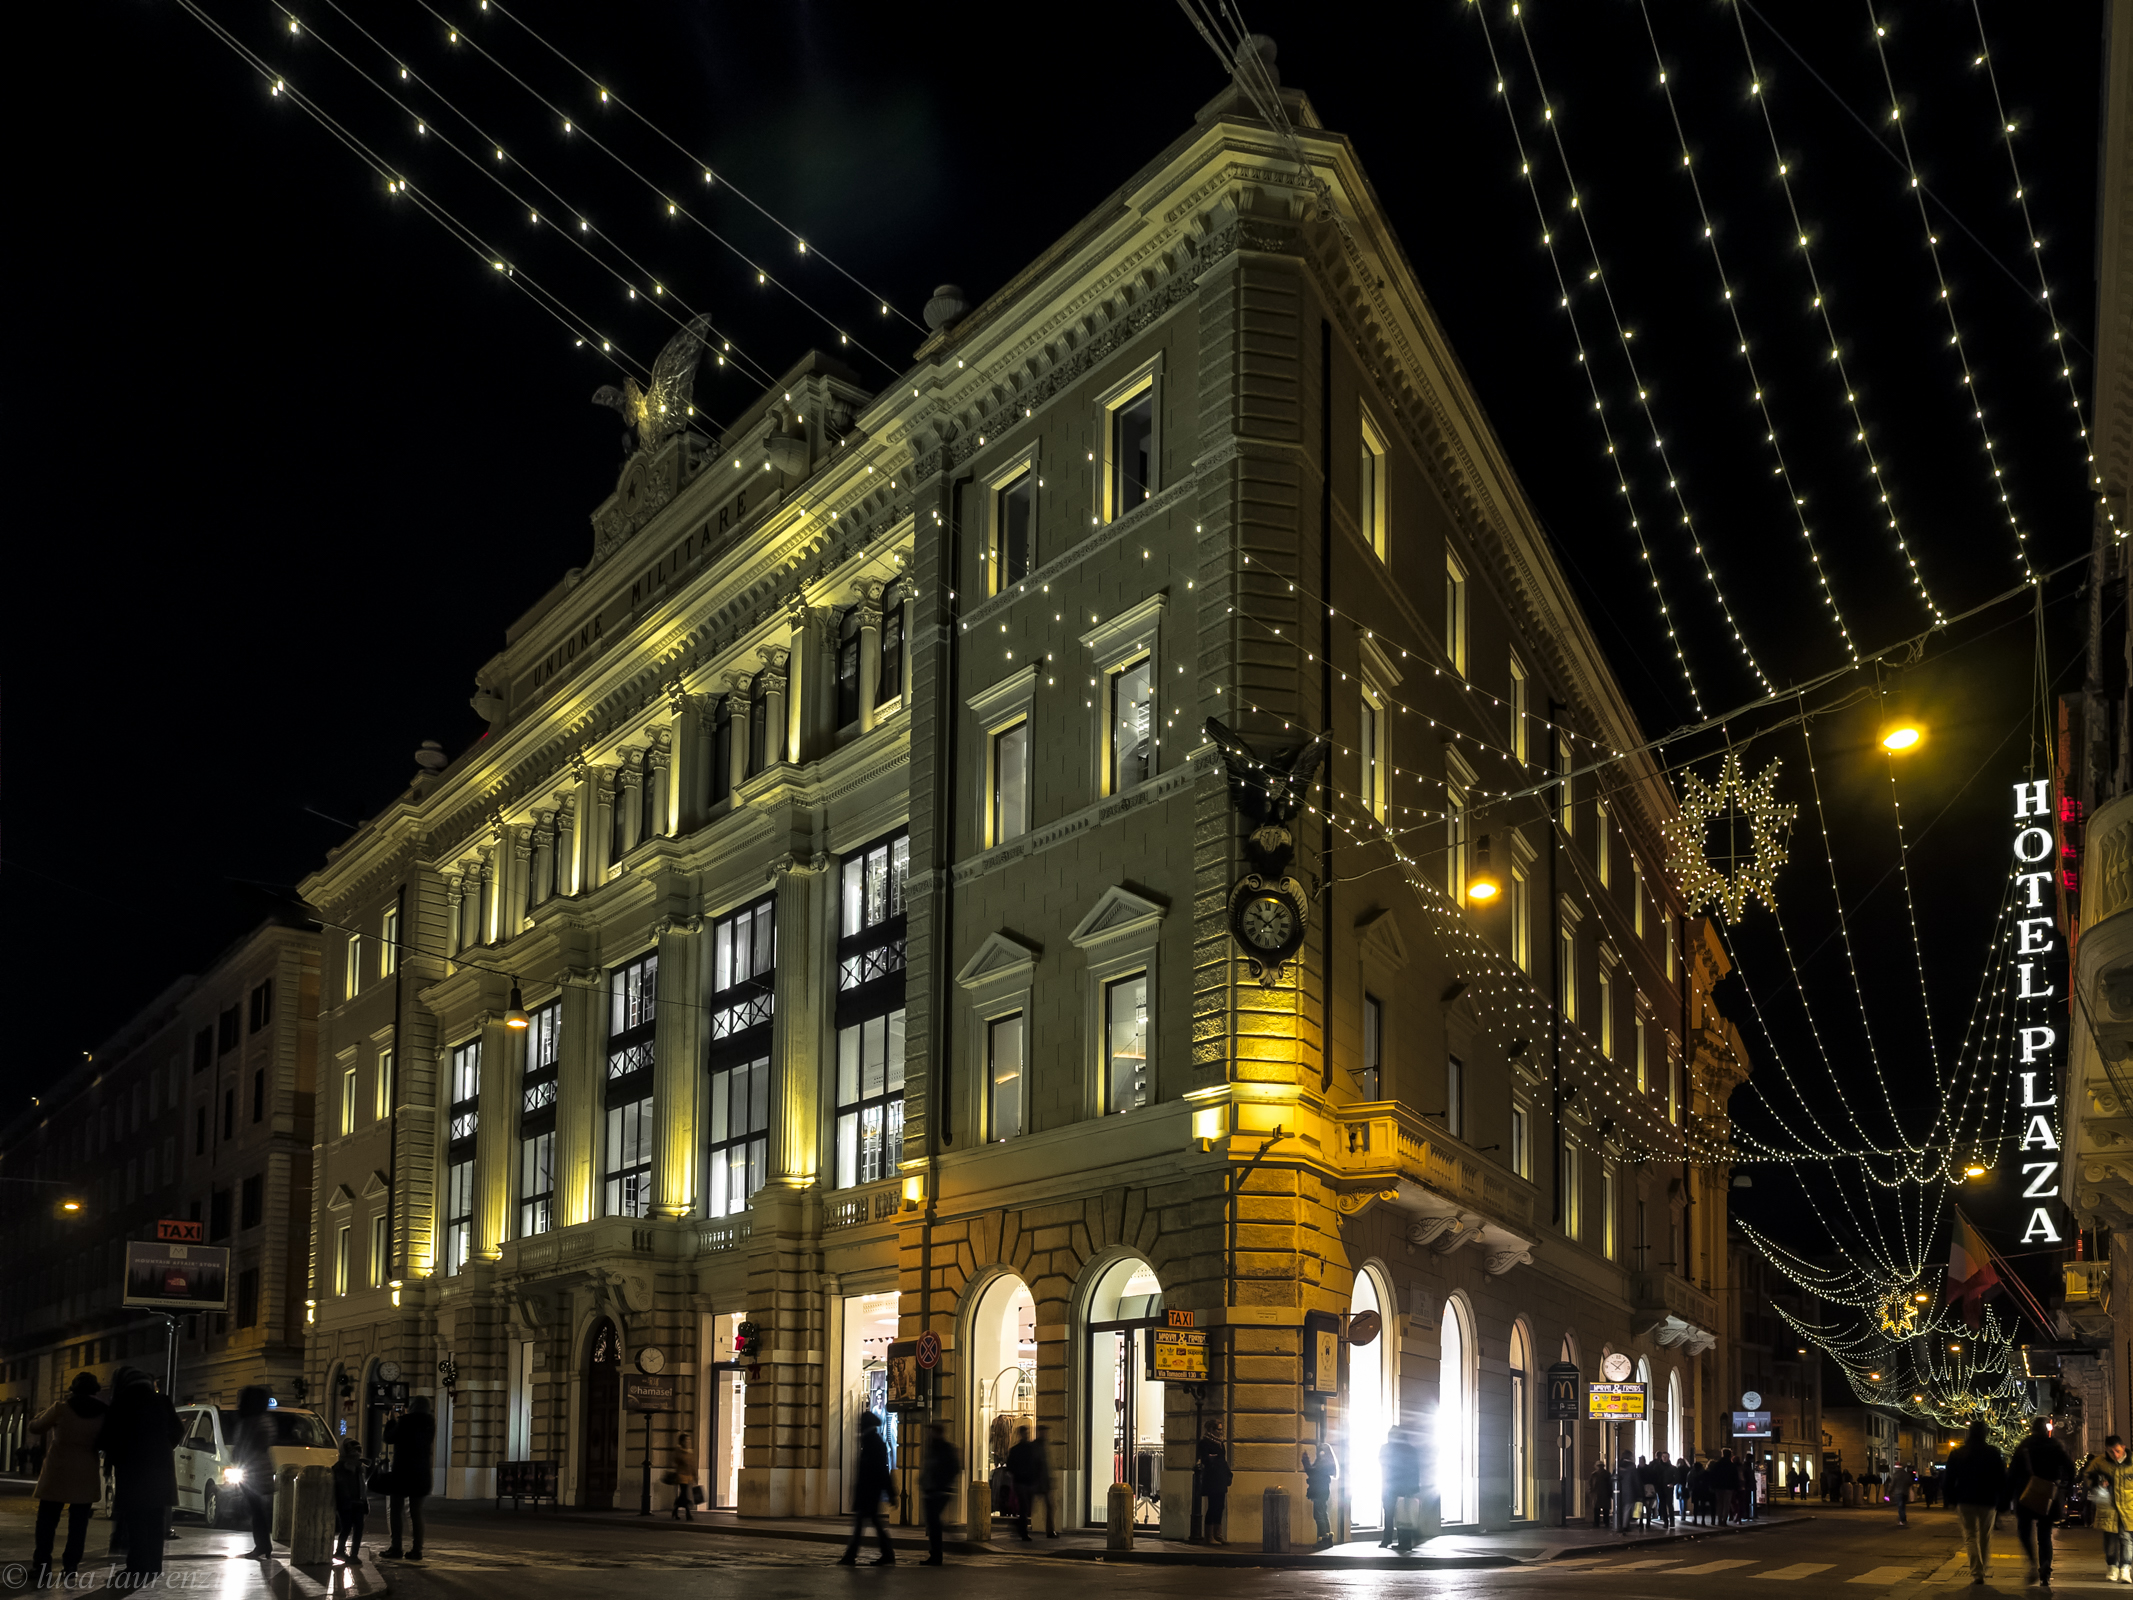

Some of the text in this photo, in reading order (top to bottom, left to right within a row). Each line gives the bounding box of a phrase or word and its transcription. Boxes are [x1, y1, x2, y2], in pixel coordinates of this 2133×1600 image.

[534, 490, 747, 687] UNIONE MILITARE
[2013, 779, 2062, 1244] HOTEL PLAZA
[160, 1224, 200, 1239] TAXI
[1170, 1311, 1192, 1326] TAXI
[1177, 1332, 1188, 1346] &
[1166, 1370, 1188, 1378] Tomacelli
[637, 1386, 673, 1397] hamasei
[1612, 1384, 1622, 1394] &
